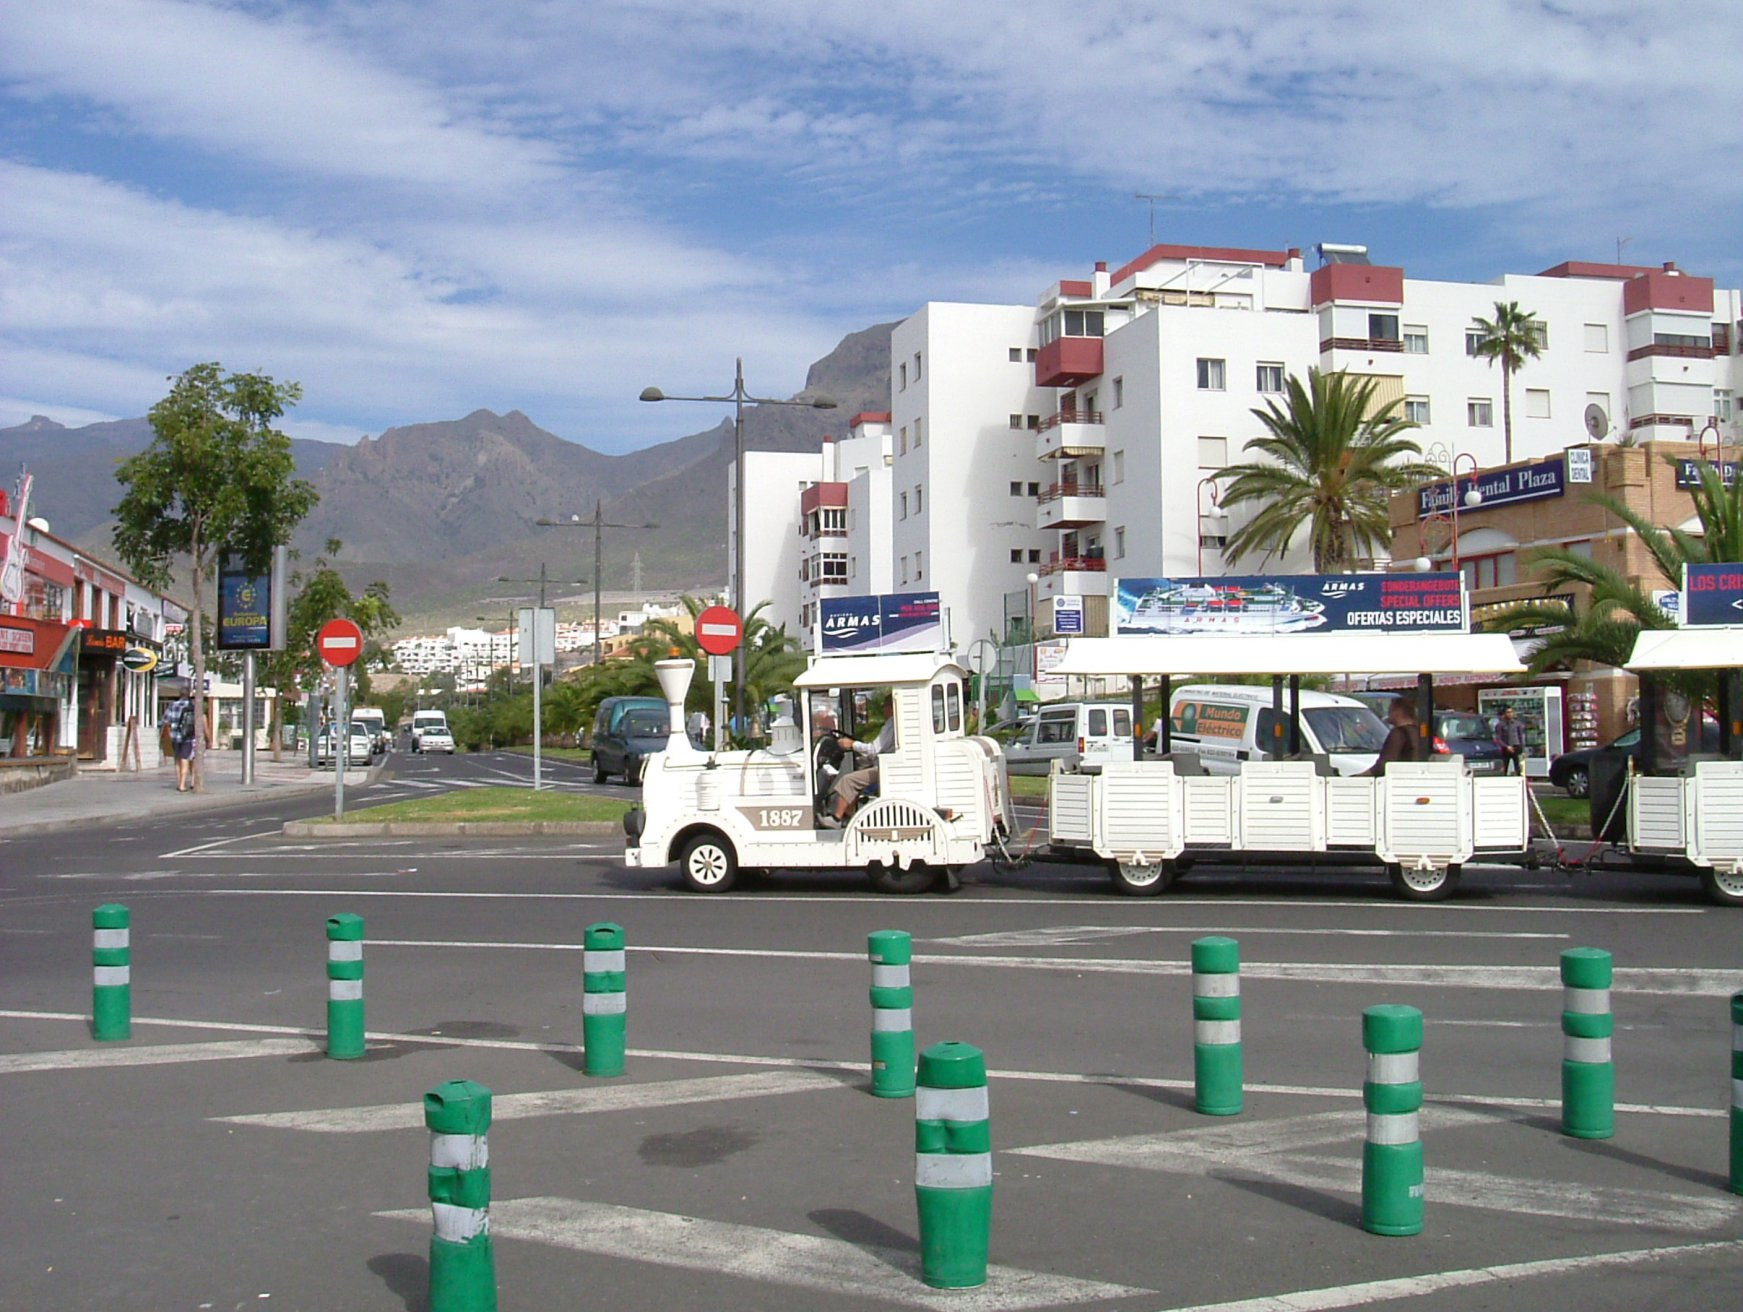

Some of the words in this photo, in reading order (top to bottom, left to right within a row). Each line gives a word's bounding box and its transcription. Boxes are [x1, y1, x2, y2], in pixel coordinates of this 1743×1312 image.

[1518, 470, 1556, 490] Plaza
[1322, 582, 1365, 591] ARMAS
[1689, 574, 1717, 592] LOS
[1381, 596, 1420, 608] SPECIAL
[1424, 594, 1461, 607] OFFERS
[825, 615, 881, 628] ARMAS
[1347, 611, 1393, 625] OFERTAS
[1396, 610, 1461, 624] ESPECIALES
[105, 635, 126, 649] BAR
[1205, 706, 1241, 720] Mundo
[1197, 721, 1242, 737] Eléctrico
[759, 810, 803, 827] 1887
